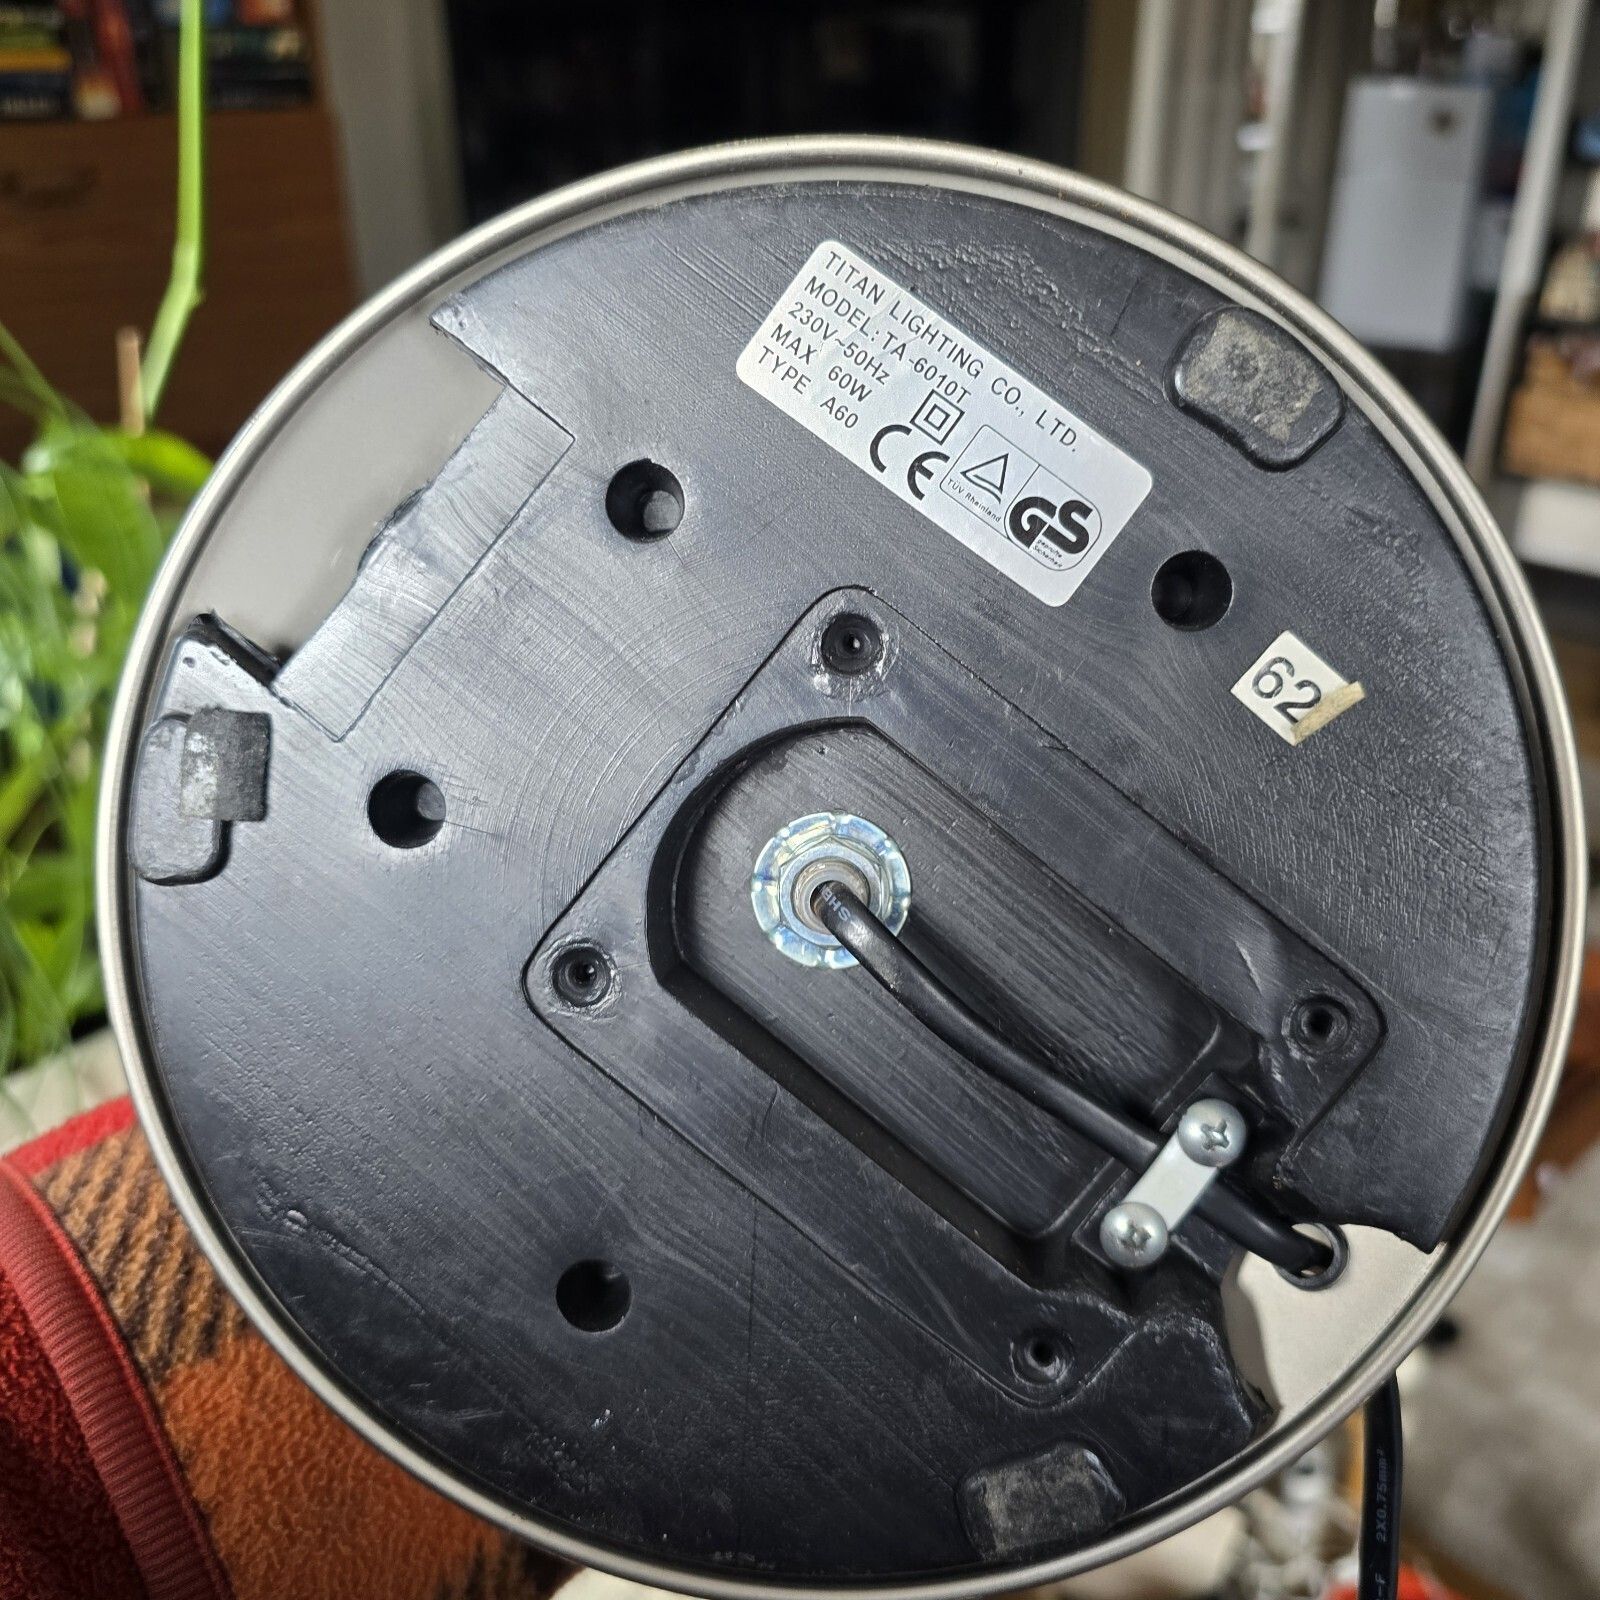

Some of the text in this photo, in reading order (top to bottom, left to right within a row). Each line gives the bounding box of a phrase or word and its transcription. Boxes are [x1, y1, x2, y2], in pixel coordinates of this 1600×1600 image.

[758, 345, 859, 429] TYPE A60
[770, 323, 873, 402] MAX 60W
[825, 251, 1077, 452] TITAN LIGHTING CO., LTD.
[947, 478, 1002, 523] TÜV Rheinland
[1009, 496, 1093, 555] GS
[1252, 656, 1321, 724] 62
